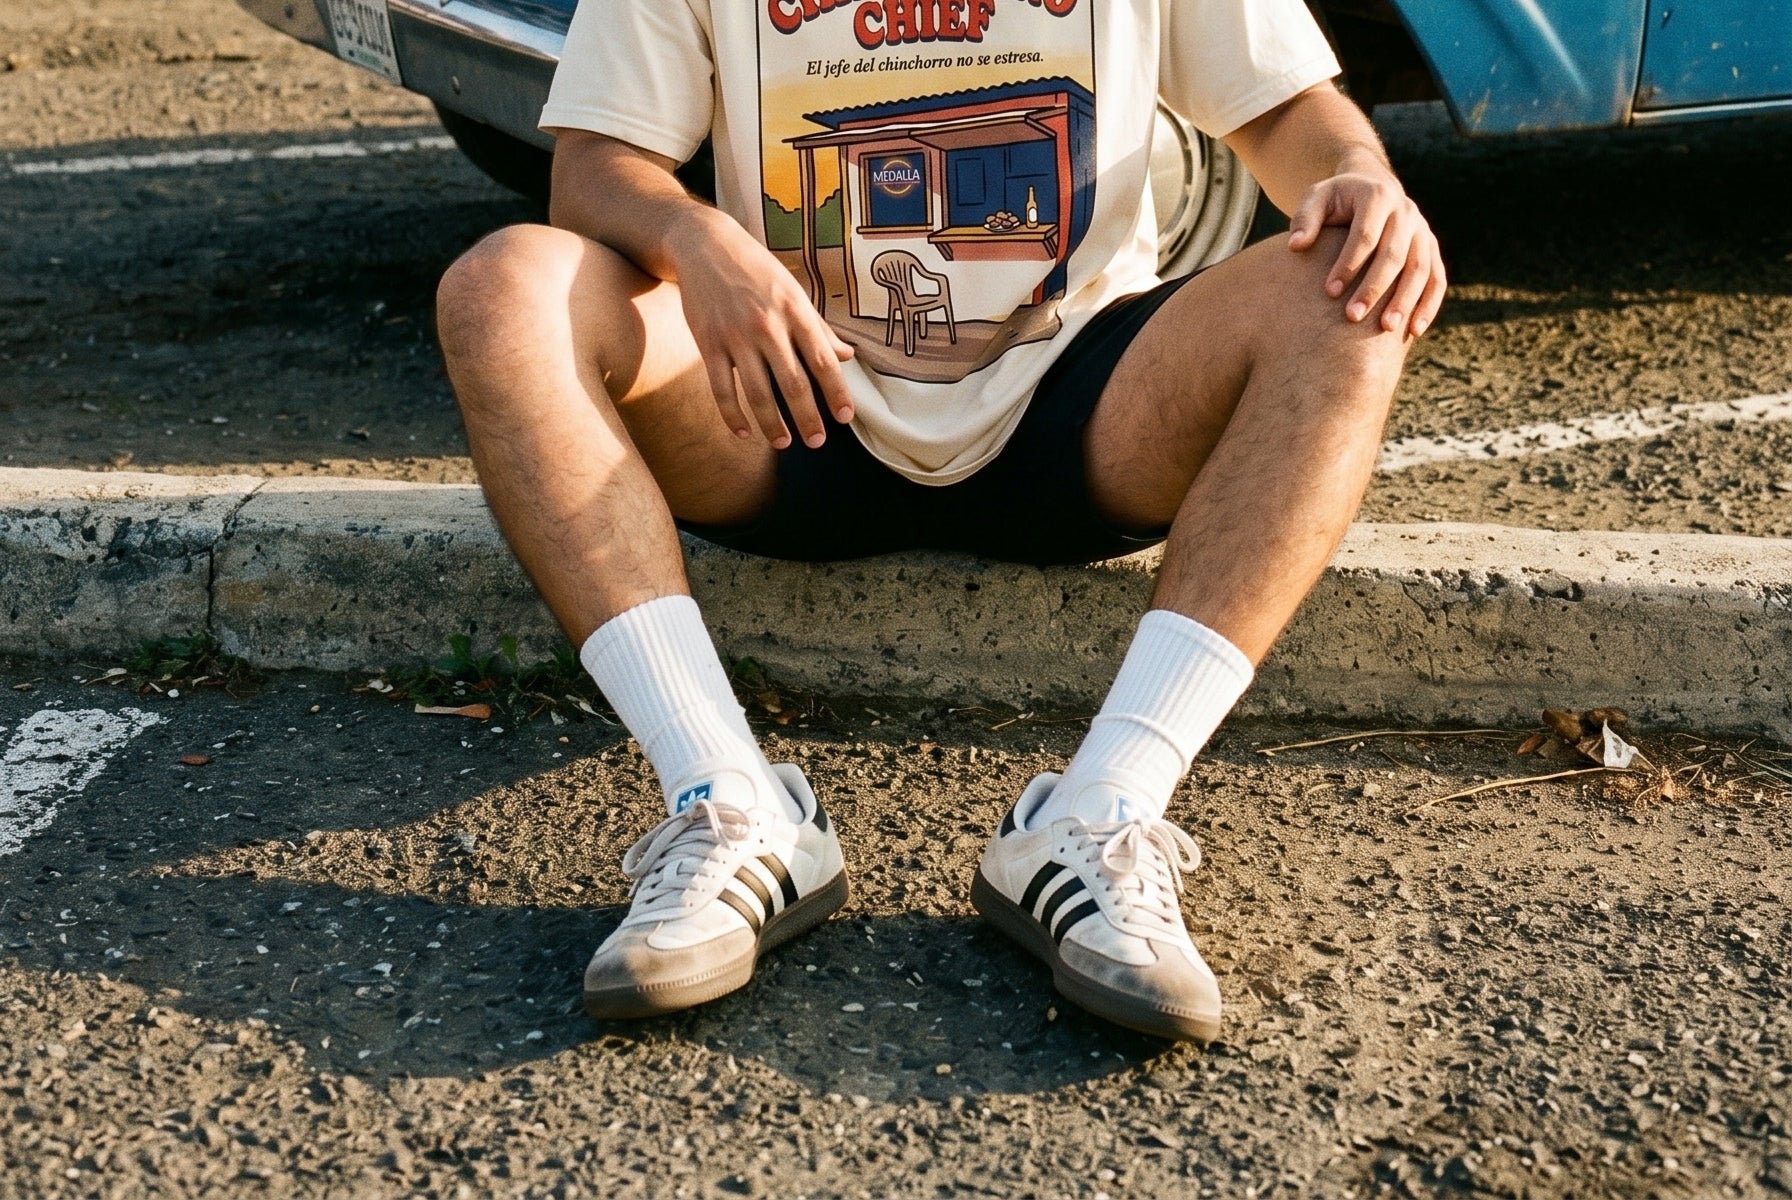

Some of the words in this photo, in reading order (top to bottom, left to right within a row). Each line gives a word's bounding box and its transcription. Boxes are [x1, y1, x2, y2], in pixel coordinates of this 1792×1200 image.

[806, 61, 821, 76] El
[823, 60, 850, 78] jefe
[853, 58, 874, 73] del
[878, 55, 953, 72] chinchorro
[956, 55, 973, 67] no
[977, 54, 991, 66] se
[994, 51, 1044, 65] estresa.
[873, 168, 920, 183] MEDALLA
